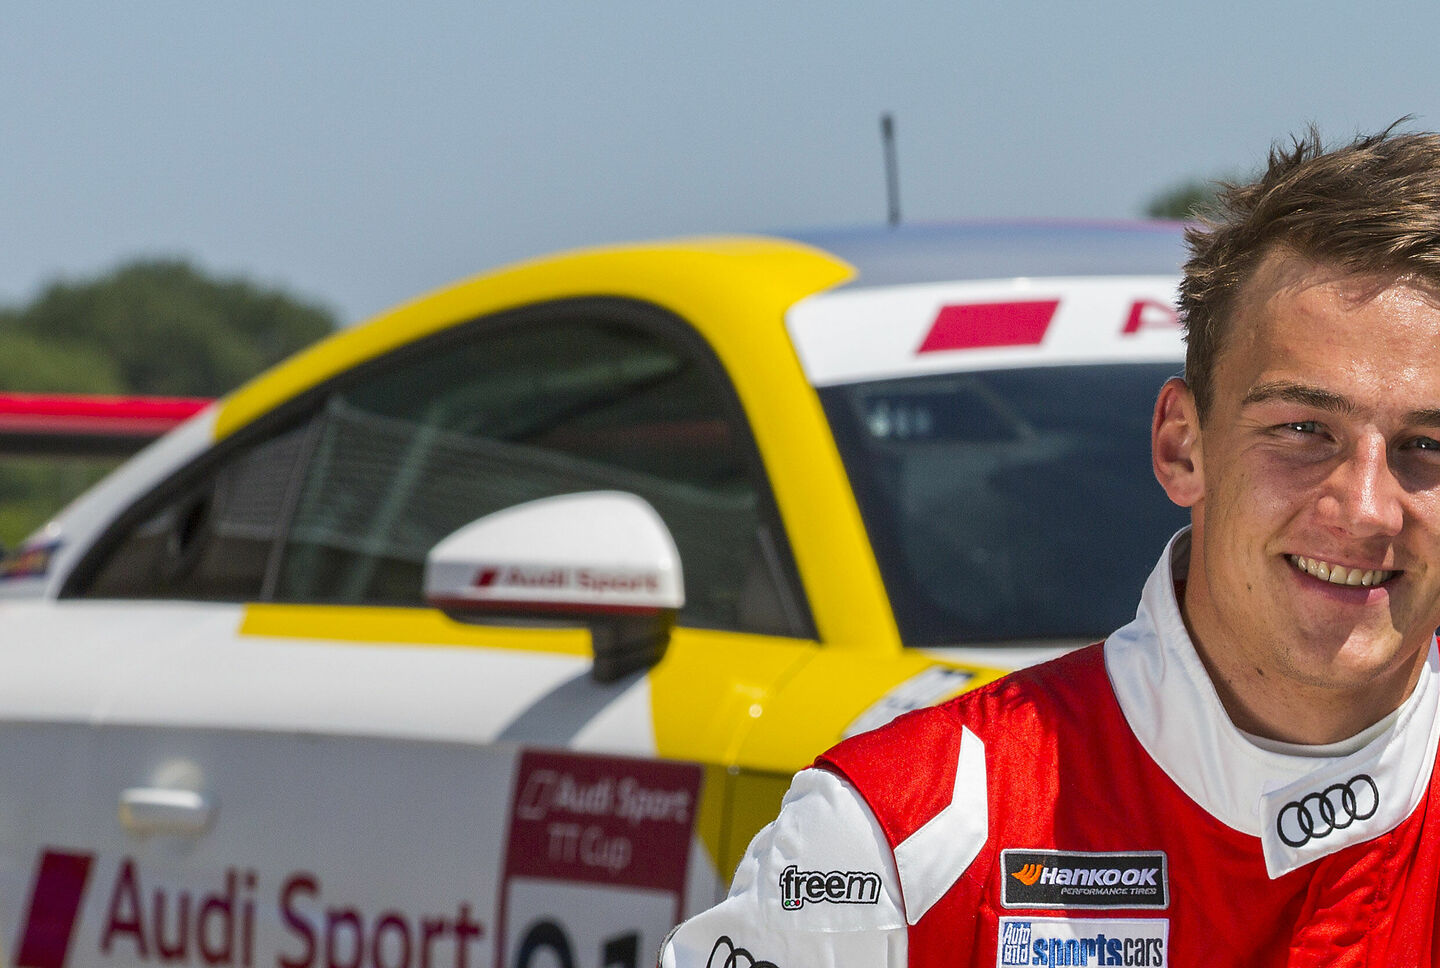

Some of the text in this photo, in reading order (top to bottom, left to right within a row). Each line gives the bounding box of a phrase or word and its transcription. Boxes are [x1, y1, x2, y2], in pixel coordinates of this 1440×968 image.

[552, 774, 689, 826] Audi Sport
[549, 823, 633, 876] TT Cup
[781, 867, 879, 902] freem
[1040, 867, 1159, 886] Hankook
[1060, 887, 1157, 895] PERFORMANCE TIRES
[1003, 923, 1031, 945] Auto
[1003, 944, 1029, 964] Bild
